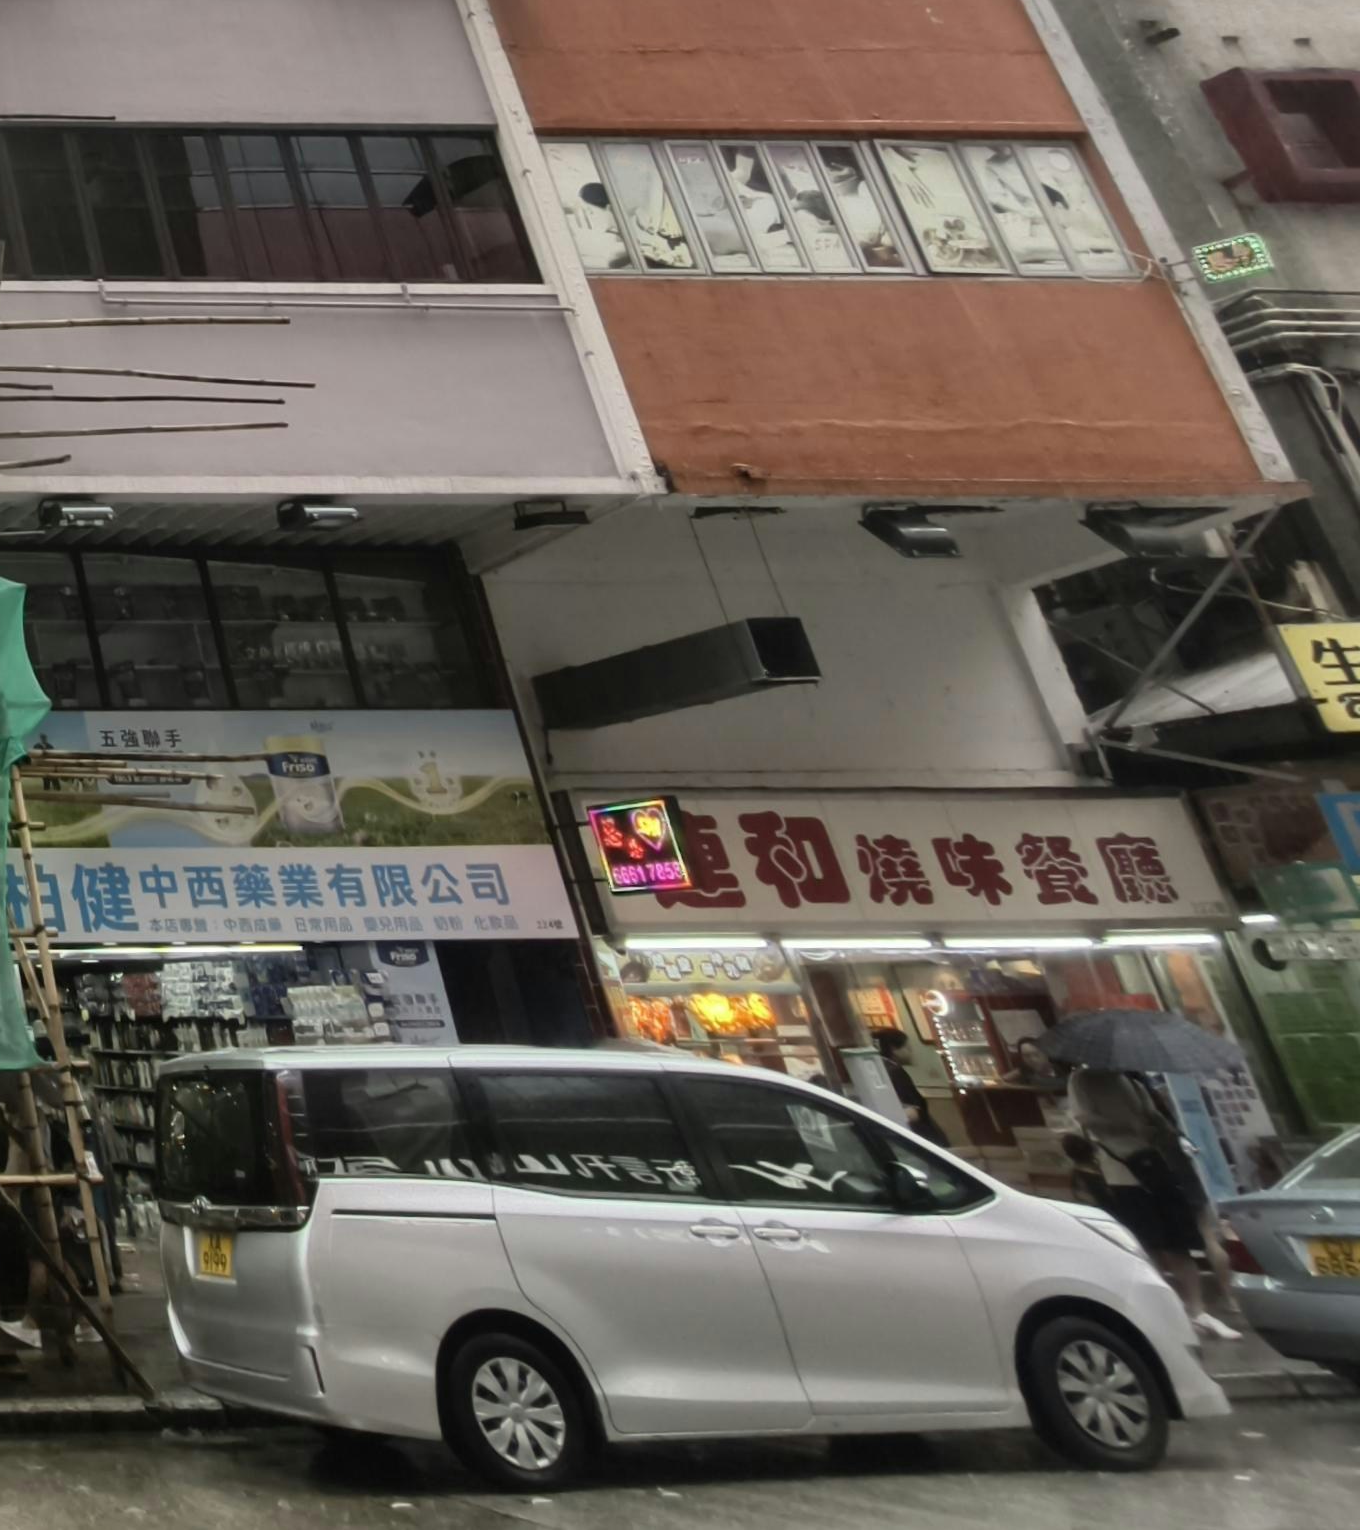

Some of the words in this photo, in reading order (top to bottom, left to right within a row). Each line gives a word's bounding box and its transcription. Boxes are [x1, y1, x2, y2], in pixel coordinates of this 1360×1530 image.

[99, 729, 182, 748] 五強聯手
[294, 917, 353, 933] 日常用品
